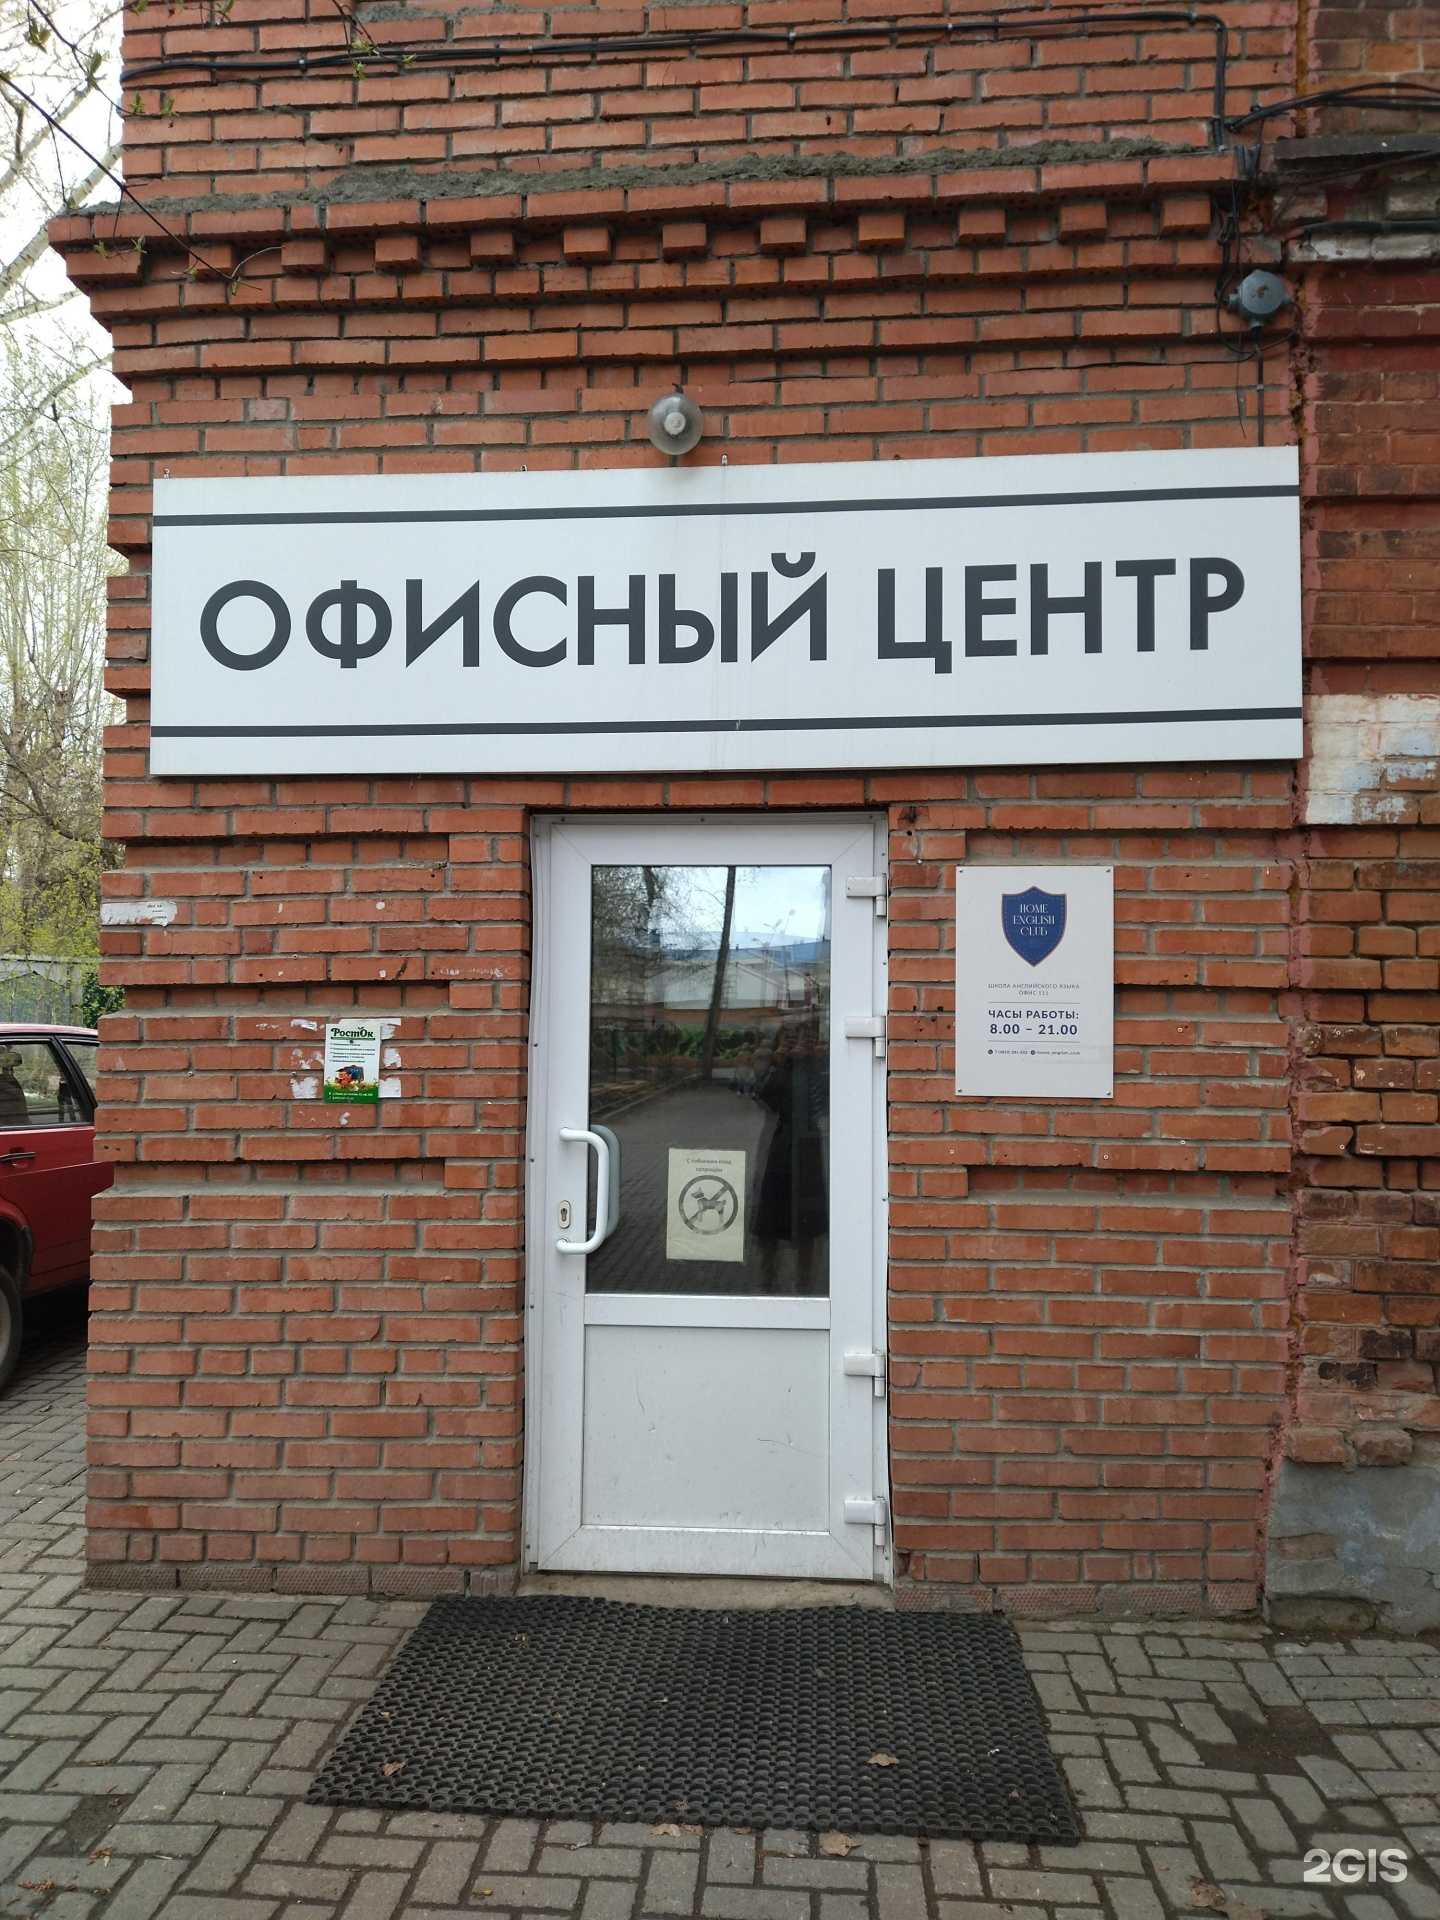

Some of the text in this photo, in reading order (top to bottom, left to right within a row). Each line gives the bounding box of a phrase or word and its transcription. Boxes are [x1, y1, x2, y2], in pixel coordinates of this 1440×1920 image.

[199, 551, 1246, 674] ОФИСНЫЙ ЦЕНТР
[1020, 903, 1048, 913] HOME
[1013, 914, 1055, 925] ENGLISH
[1020, 926, 1048, 936] CLUB
[988, 1009, 1080, 1020] ЧАСЫ РАБОТЫ:
[990, 1023, 1020, 1034] 8.00
[1038, 1024, 1078, 1035] 21.00
